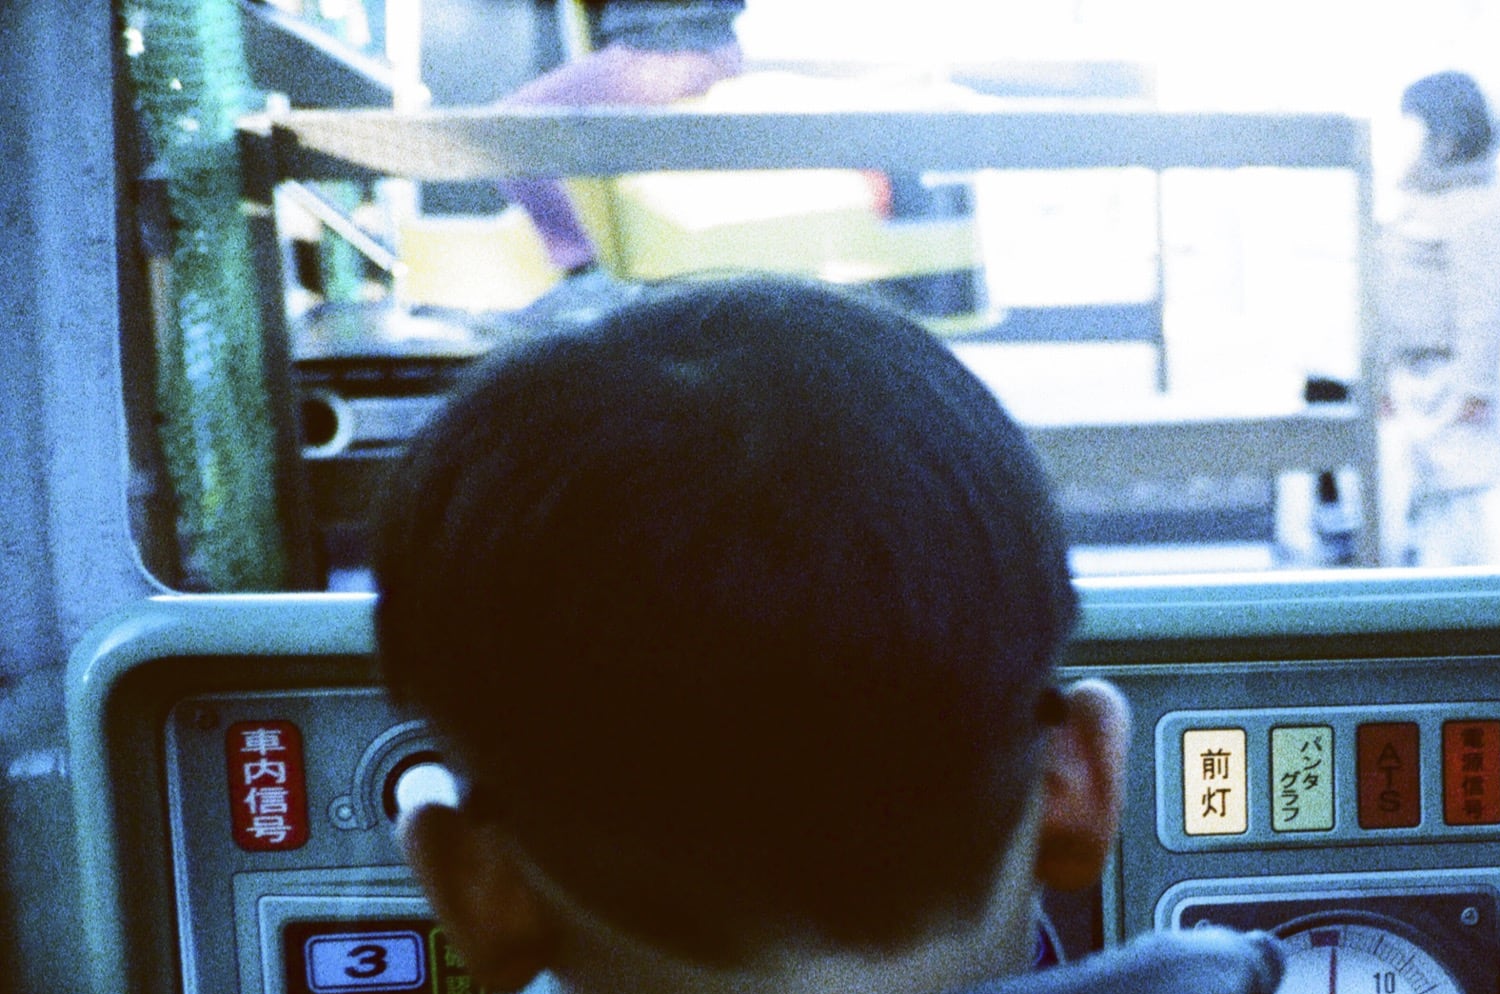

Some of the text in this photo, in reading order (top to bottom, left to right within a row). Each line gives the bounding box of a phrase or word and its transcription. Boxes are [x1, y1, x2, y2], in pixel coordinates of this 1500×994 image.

[241, 728, 292, 843] 車内信号
[1200, 748, 1231, 818] 前灯
[1300, 735, 1323, 790] パンタ
[1377, 742, 1400, 812] ATS
[1281, 770, 1301, 822] グラフ
[344, 944, 388, 979] 3
[1372, 972, 1396, 994] 10
